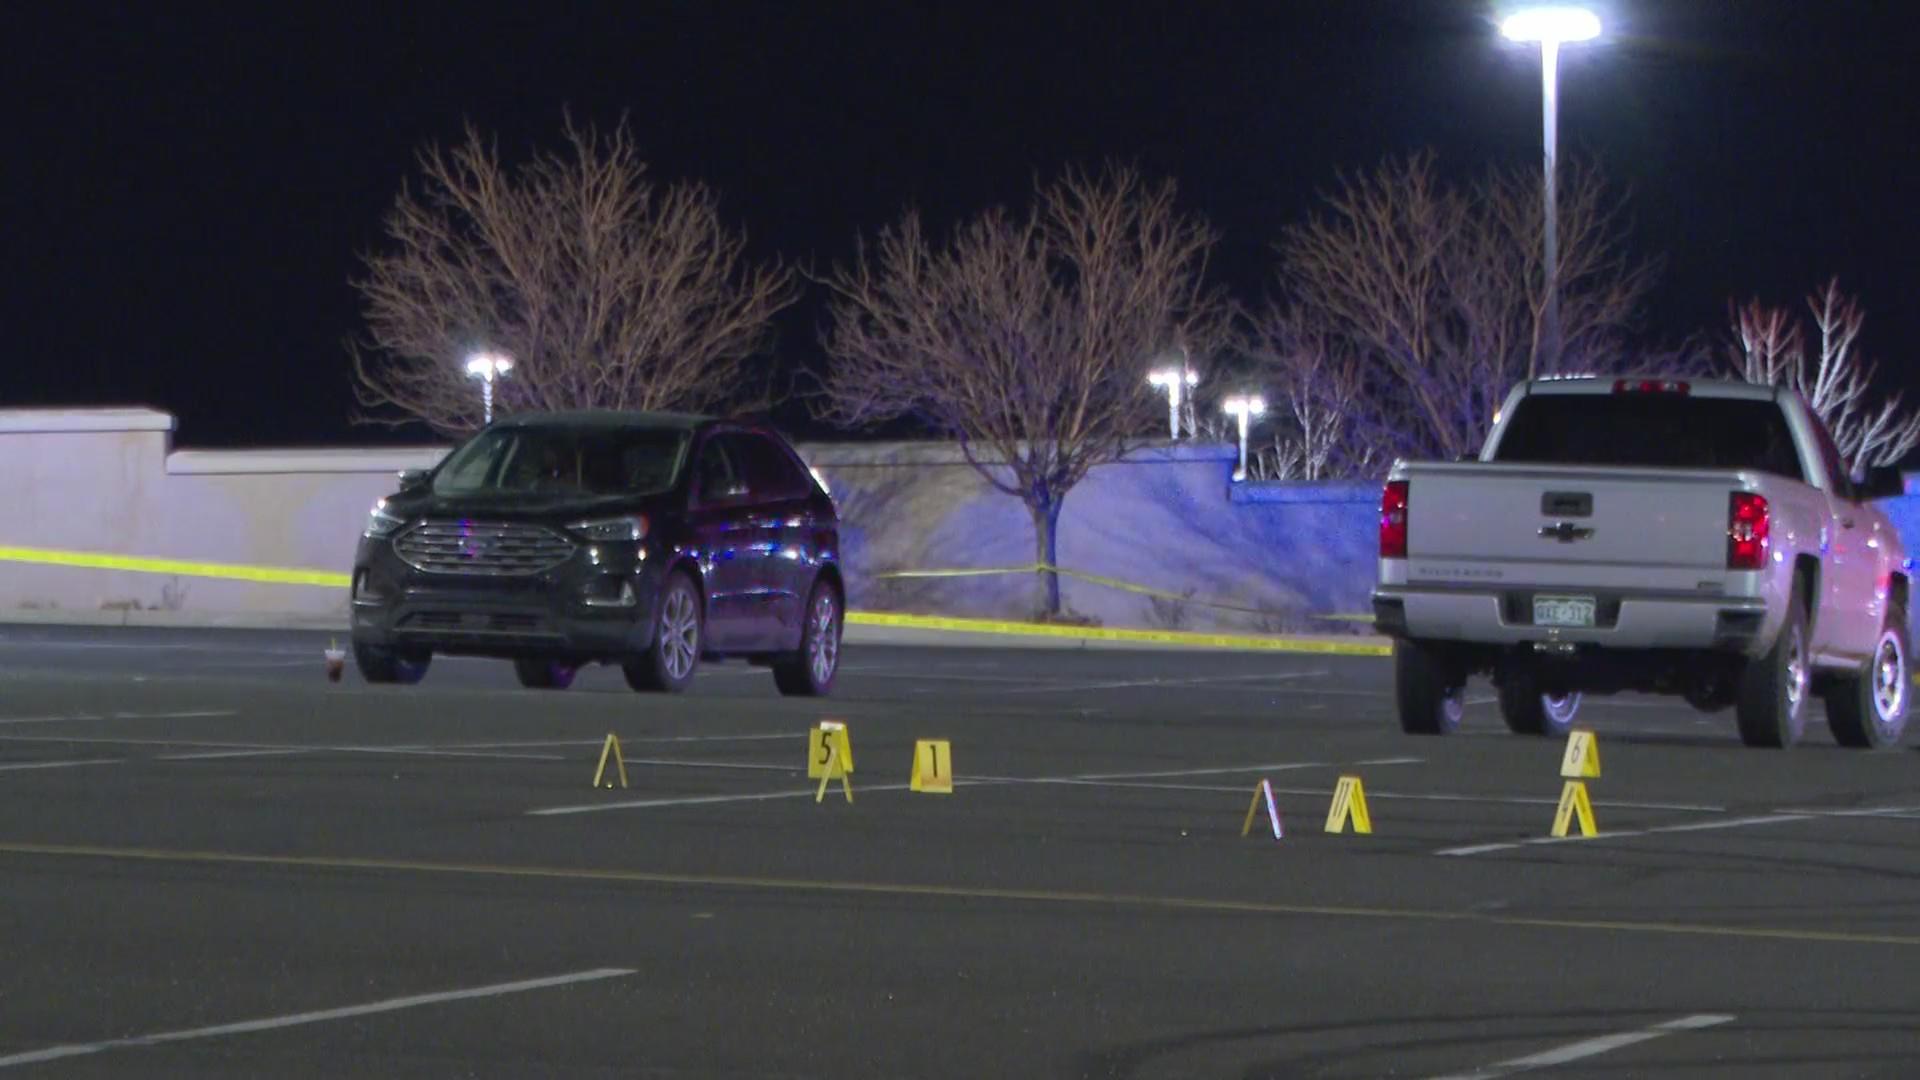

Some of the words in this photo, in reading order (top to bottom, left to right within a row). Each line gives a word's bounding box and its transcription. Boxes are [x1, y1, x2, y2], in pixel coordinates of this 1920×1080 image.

[818, 732, 832, 765] 5
[930, 744, 938, 778] 1
[1571, 735, 1582, 764] 6
